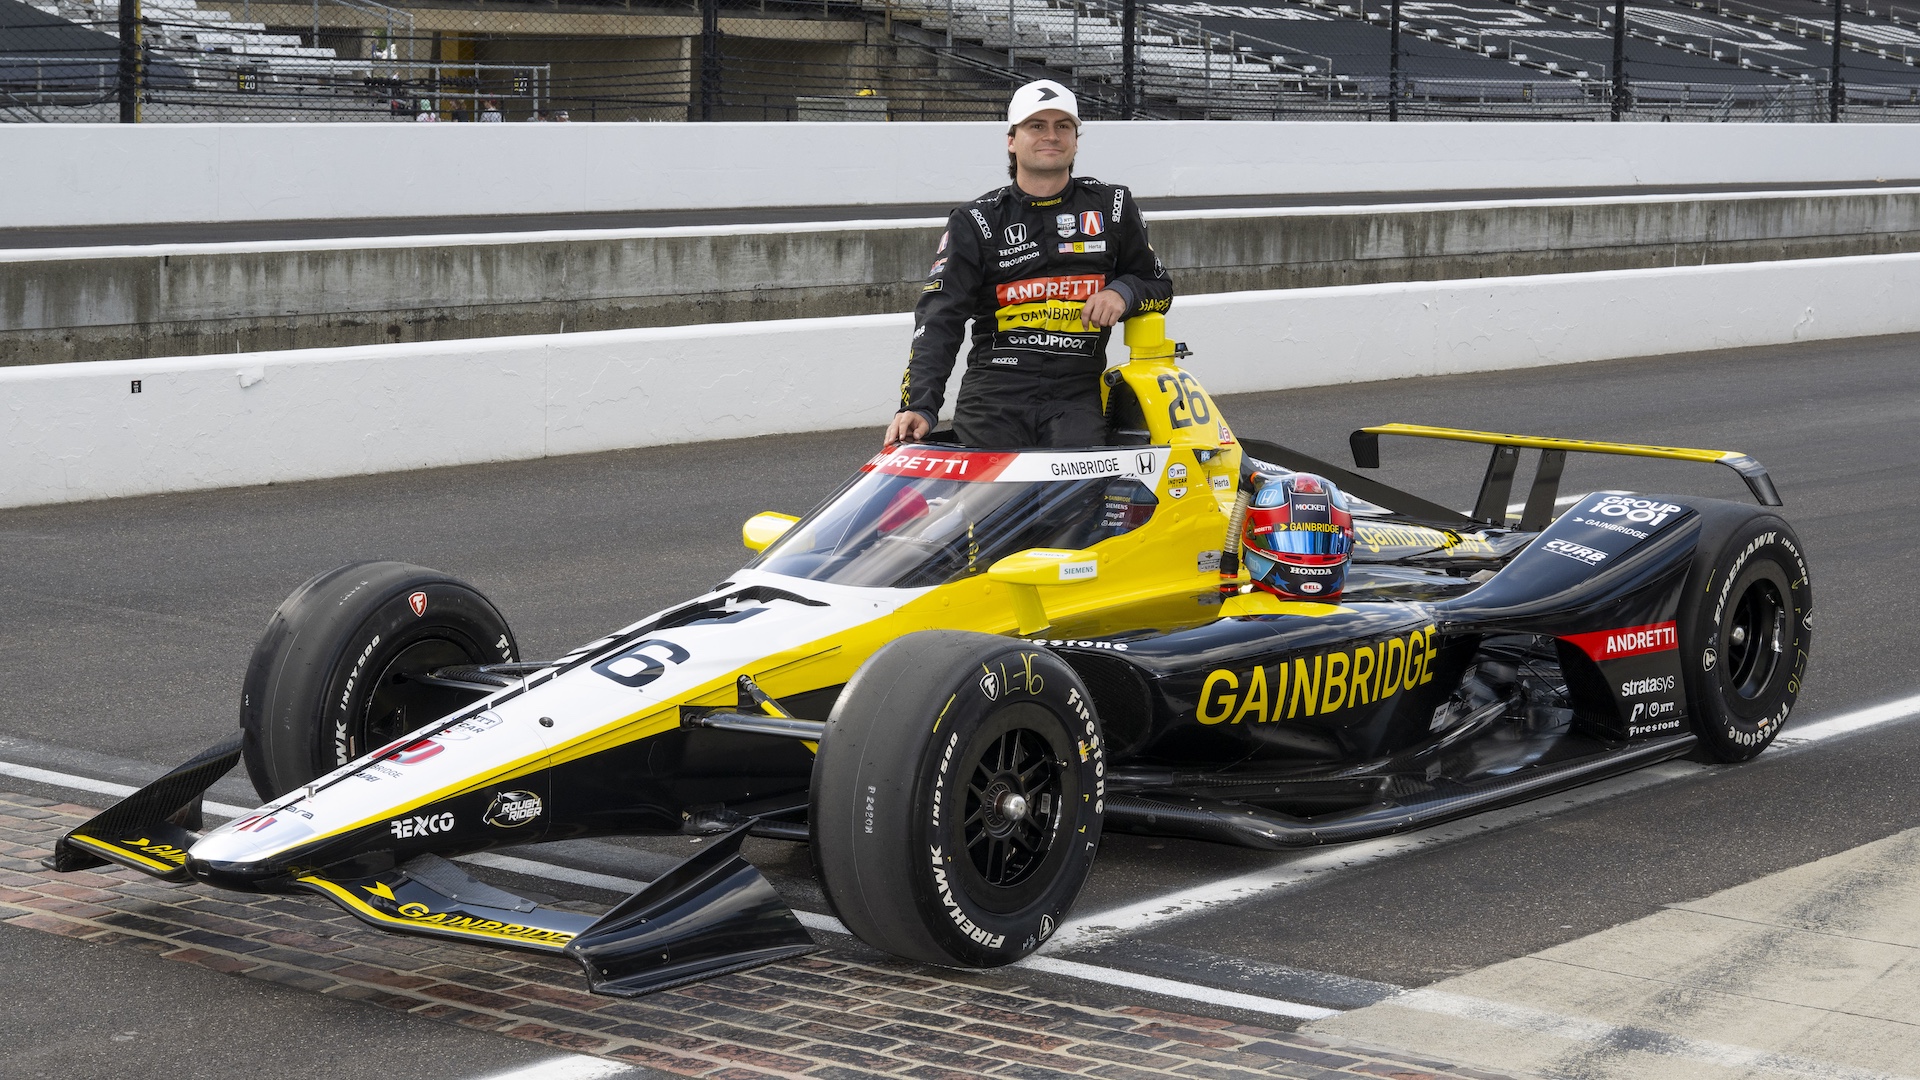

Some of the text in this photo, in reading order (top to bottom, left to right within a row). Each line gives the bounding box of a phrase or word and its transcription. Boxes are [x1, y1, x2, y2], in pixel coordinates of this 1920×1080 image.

[1111, 188, 1125, 222] sparco
[969, 208, 992, 240] sparco
[998, 241, 1038, 257] HONDA
[998, 251, 1040, 268] GROUP1001
[1006, 279, 1099, 302] ANDRETTI
[1020, 307, 1084, 322] GAINBRID
[1008, 334, 1086, 349] GROUP1001
[1157, 372, 1210, 430] 26
[1050, 457, 1120, 476] GAINBRIDGE
[1213, 479, 1229, 488] Herta
[1105, 502, 1128, 510] SIEMENS
[1588, 502, 1669, 527] 1001
[1602, 496, 1682, 513] GROUP
[1289, 522, 1340, 534] GAINBRIDGE
[1585, 519, 1649, 540] GAINBRIDGE
[1546, 541, 1607, 562] CURB
[1064, 566, 1094, 575] SIEMENS
[1290, 566, 1333, 576] HONDA
[1714, 532, 1777, 626] FIREHAWK
[1781, 537, 1800, 558] INDY
[1606, 627, 1675, 653] ANDRETTI
[340, 665, 359, 711] INDY
[357, 634, 381, 667] 500
[1196, 624, 1437, 725] GAINBRIDGE
[1621, 675, 1675, 697] stratasys
[1660, 702, 1675, 713] NTT
[1629, 719, 1680, 737] Firestone
[1728, 702, 1789, 747] Firestone
[1067, 687, 1105, 815] Firestone
[501, 798, 541, 813] ROUGH
[508, 807, 542, 821] RIDER
[390, 812, 455, 839] REXCO
[930, 732, 1006, 949] FIREHAWK INDY 500
[397, 902, 575, 943] GAINBRIDG
